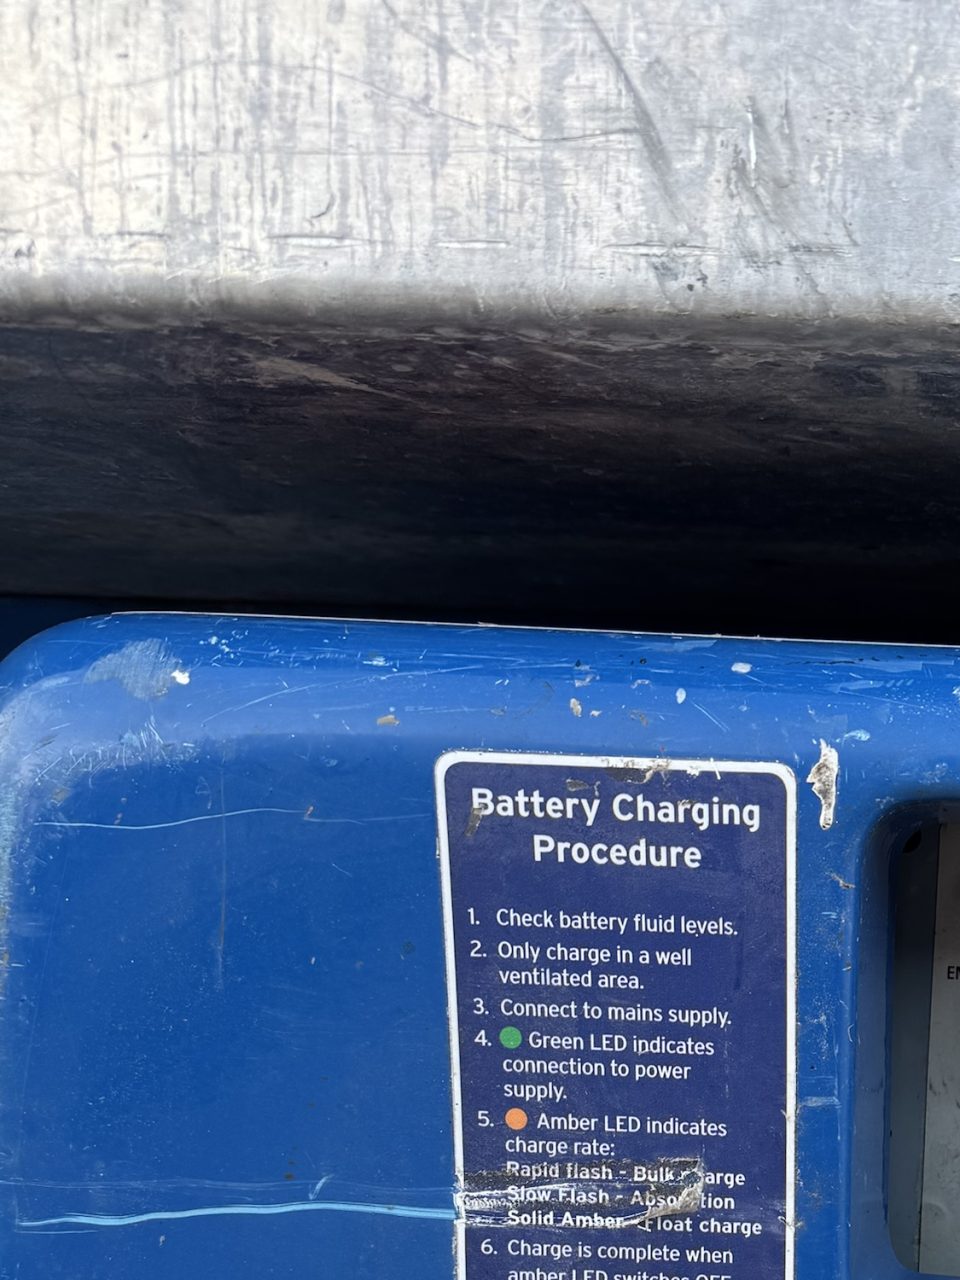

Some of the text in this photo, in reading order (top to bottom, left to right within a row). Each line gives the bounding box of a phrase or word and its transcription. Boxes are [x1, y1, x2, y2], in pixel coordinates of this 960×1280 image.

[471, 787, 760, 833] Battery Charging
[533, 835, 702, 868] Procedure
[467, 907, 738, 937] 1. Check battery fluid levels.
[470, 939, 692, 966] 2. Only charge in a well
[498, 968, 644, 989] ventilated area.
[473, 997, 732, 1028] 3. Connect to mains supply.
[474, 1029, 715, 1056] 4. Green LED indicates
[502, 1058, 692, 1081] connection to power
[503, 1081, 567, 1103] supply.
[477, 1110, 728, 1137] 5. Amber LED indicates
[505, 1135, 615, 1157] charge rate:
[480, 1238, 733, 1263] 6. Charge is complete when
